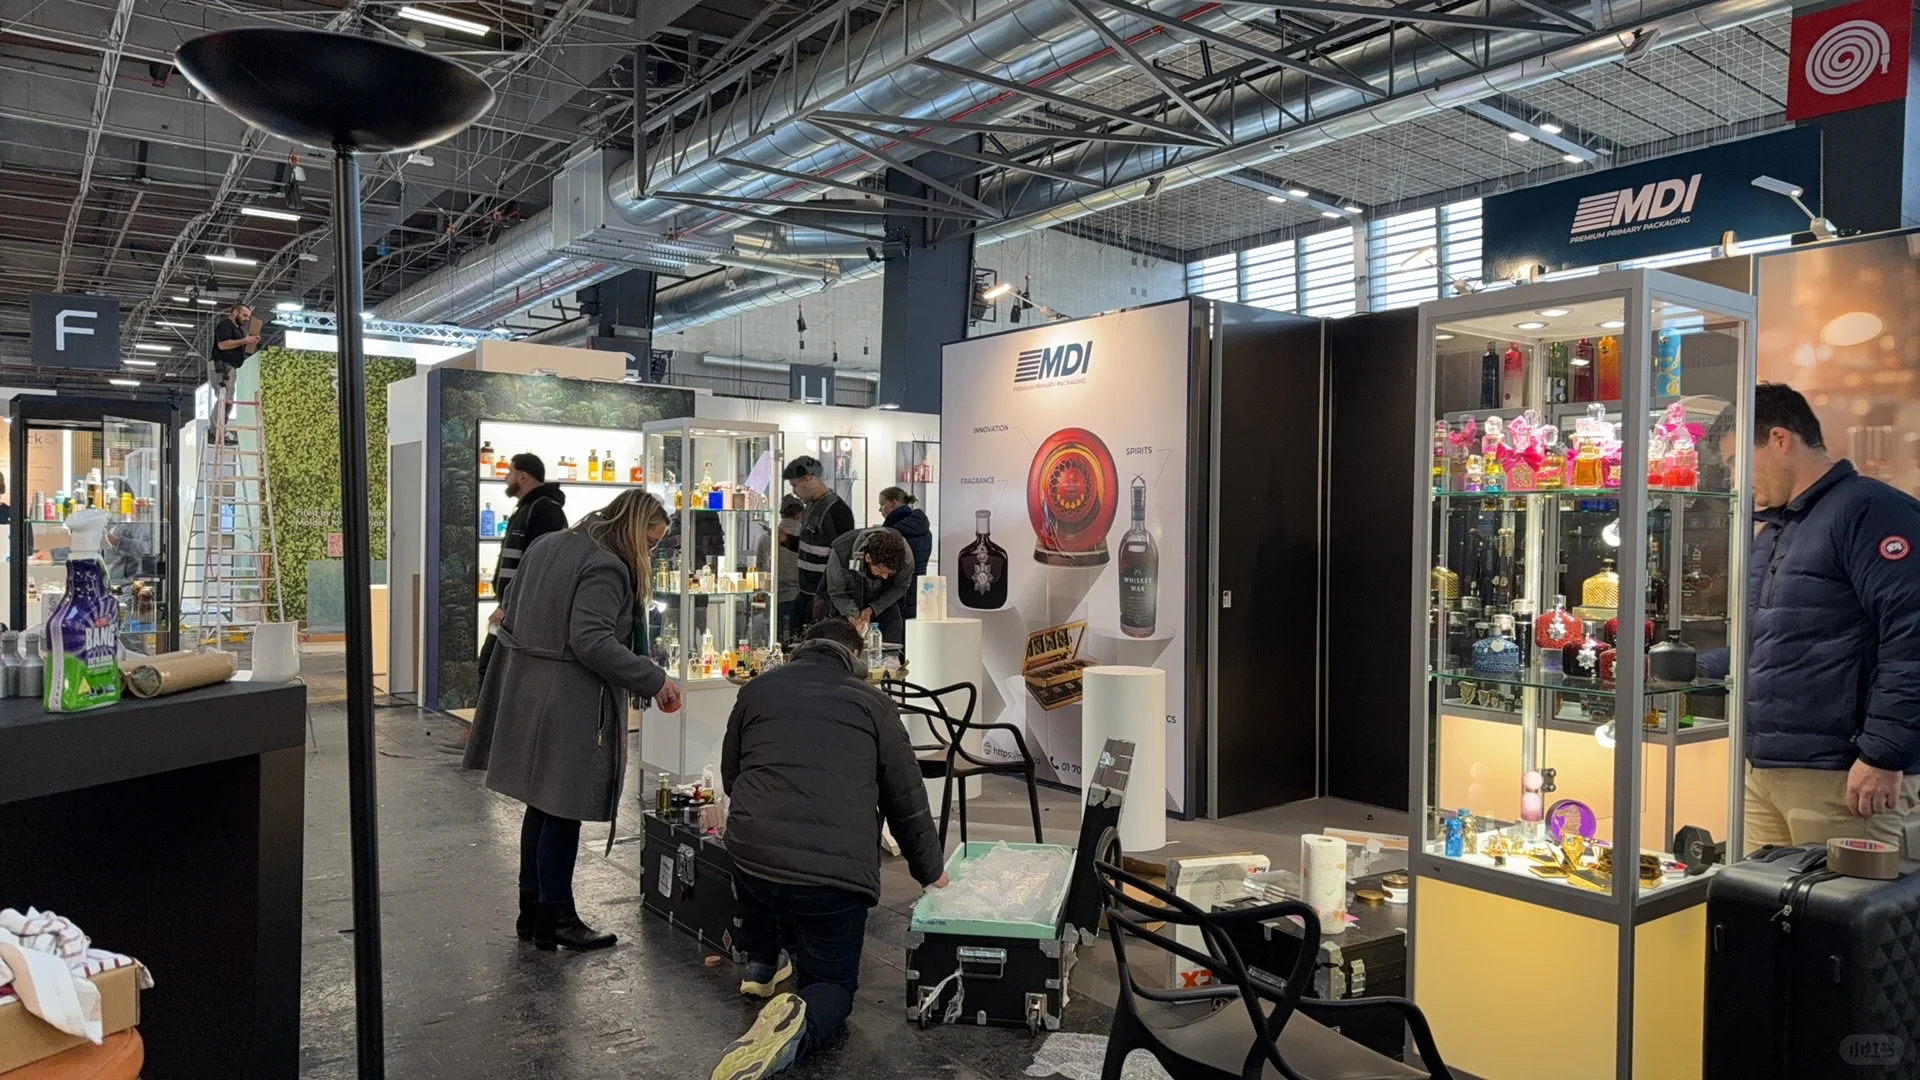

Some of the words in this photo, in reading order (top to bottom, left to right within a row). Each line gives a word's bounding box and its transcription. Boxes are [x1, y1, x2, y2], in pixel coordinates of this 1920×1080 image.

[1611, 173, 1702, 226] MDI
[1570, 231, 1605, 243] PREMIUM
[1606, 225, 1642, 237] PRIMARY
[1643, 216, 1691, 231] PACKAGING
[56, 310, 97, 351] F
[1038, 340, 1093, 380] MDI
[1035, 382, 1056, 390] PRIMARY
[1057, 378, 1087, 386] PACKAGING
[973, 424, 1009, 434] INNOVATION
[1126, 446, 1153, 456] SPIRITS
[960, 477, 995, 485] FRAGRANCE
[1124, 576, 1152, 584] WHISKEY
[85, 622, 116, 651] BANG
[1061, 762, 1070, 772] 01
[1072, 764, 1082, 774] 70
